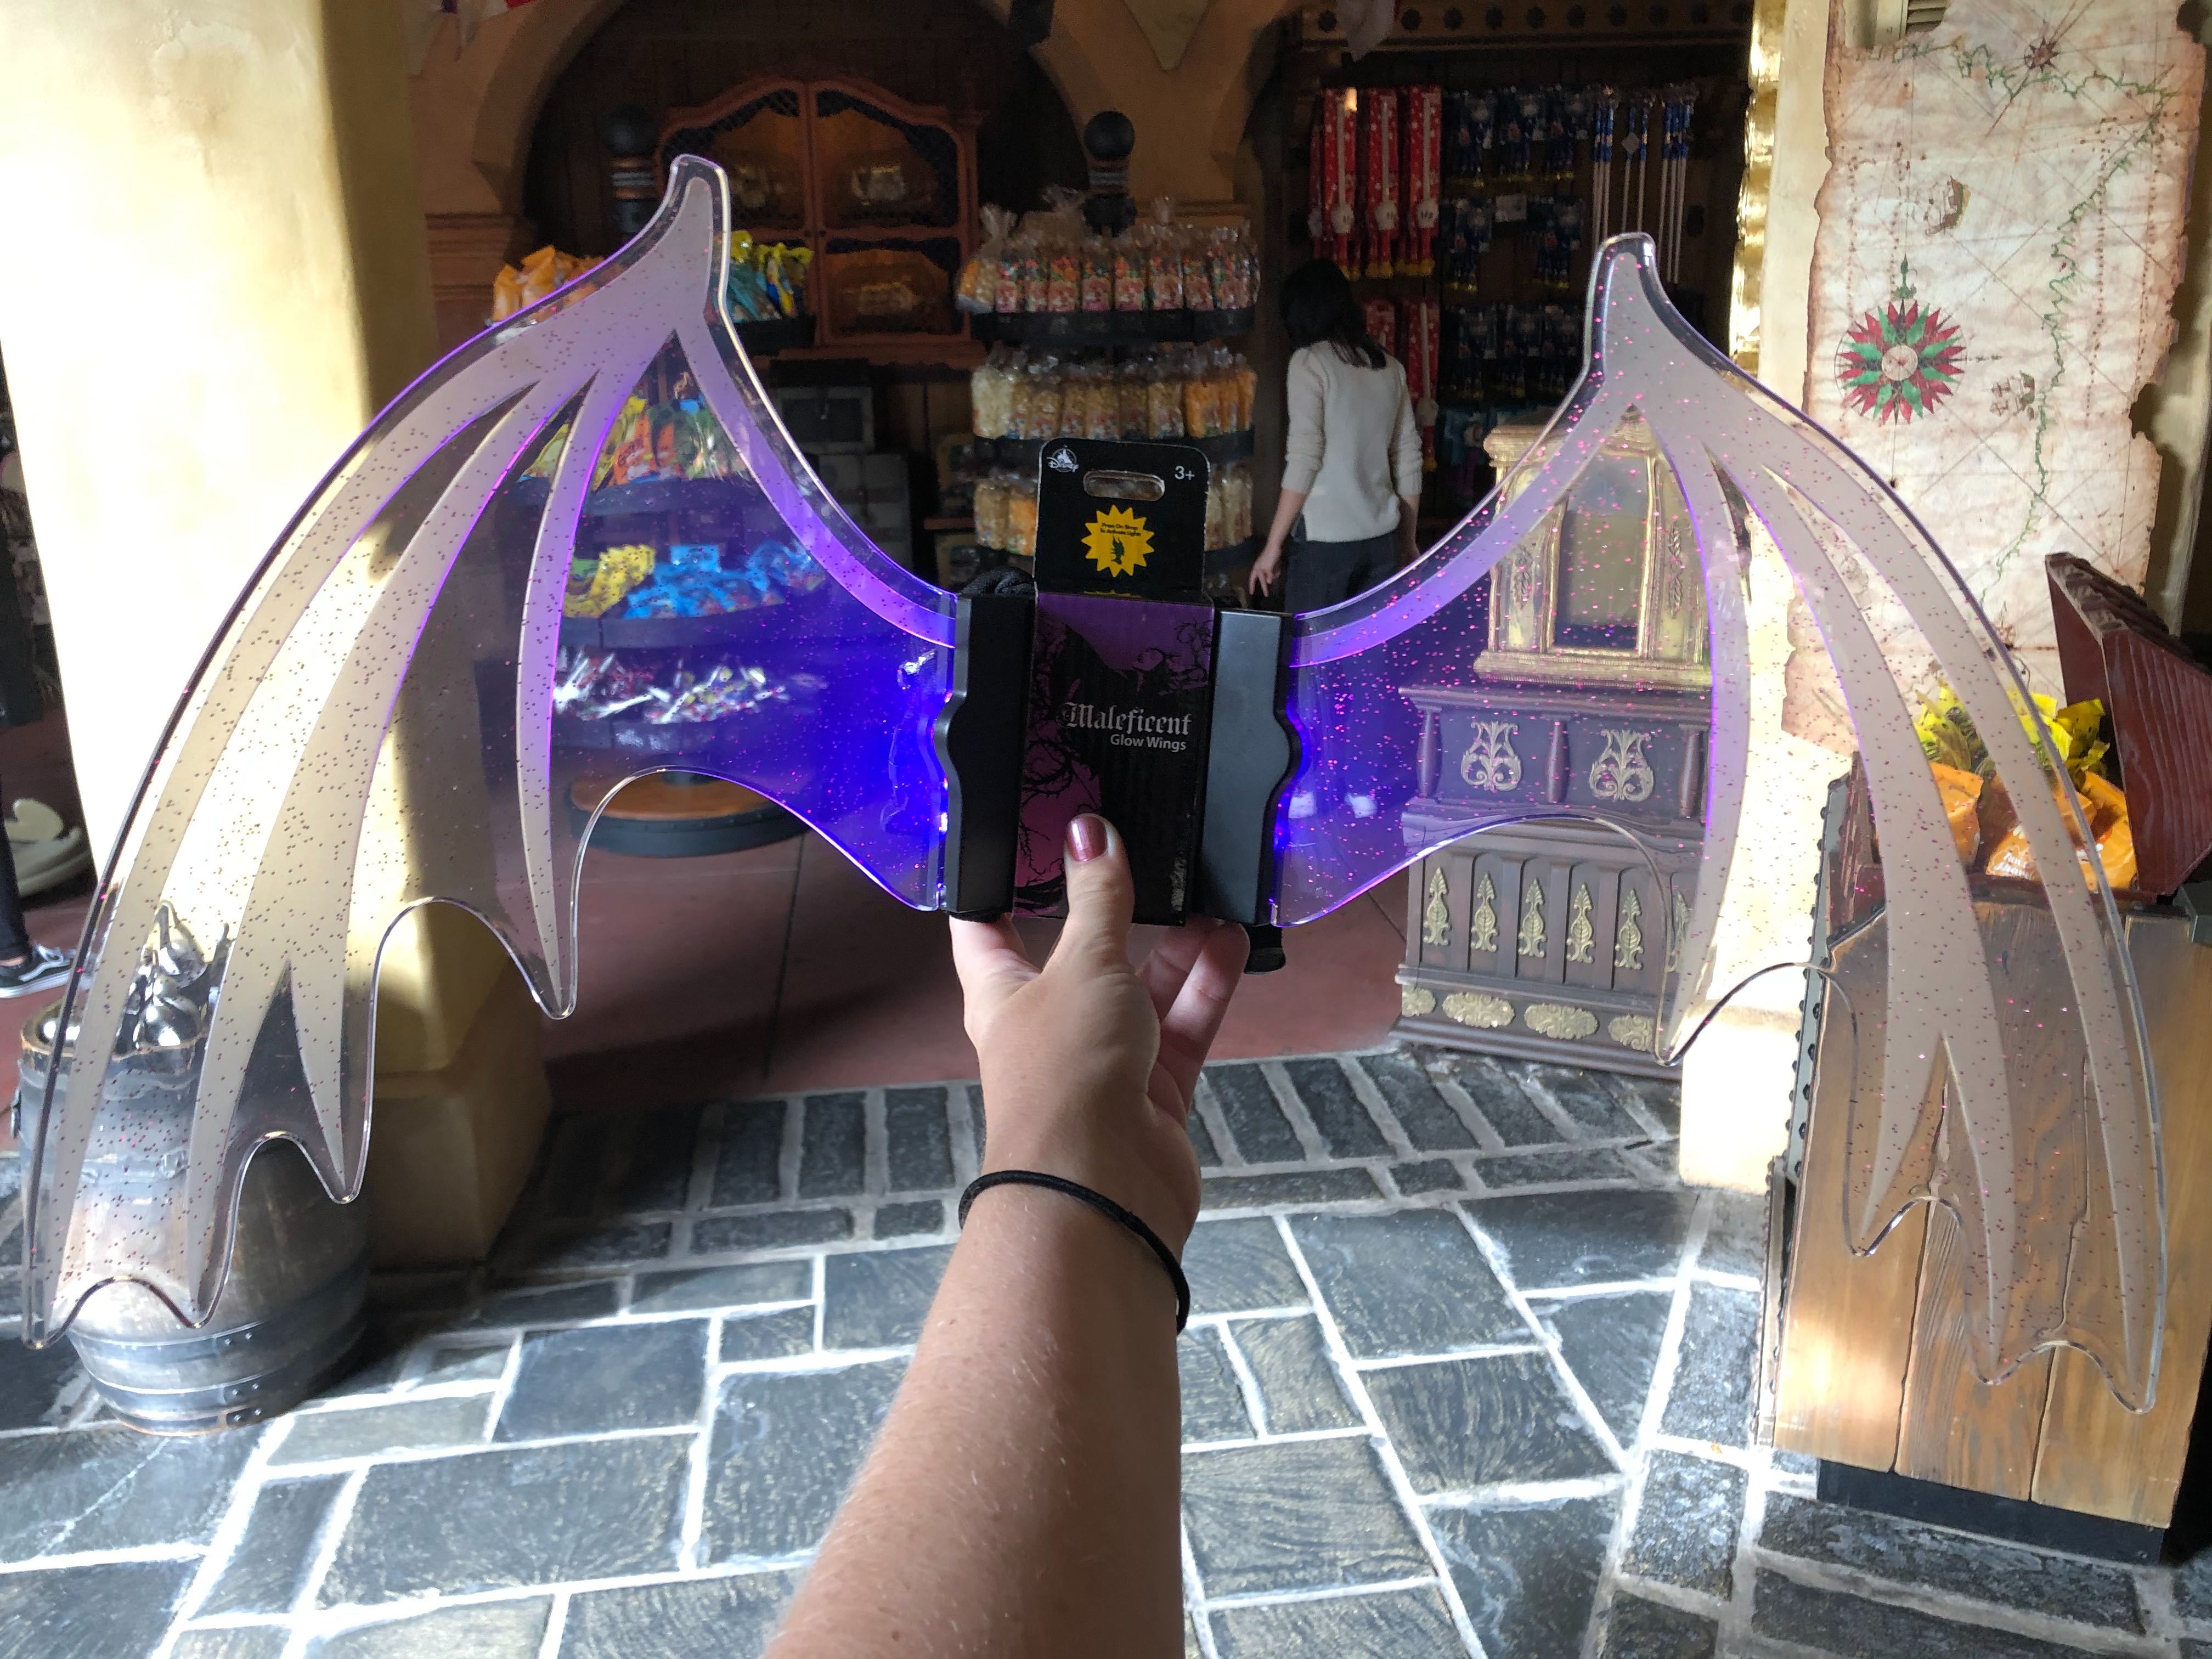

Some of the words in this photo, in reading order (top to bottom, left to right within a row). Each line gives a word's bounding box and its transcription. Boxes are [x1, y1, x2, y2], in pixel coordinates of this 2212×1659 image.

[1174, 465, 1195, 481] 3+
[1061, 702, 1192, 736] Maleficent
[1110, 733, 1144, 747] Glow
[1146, 736, 1187, 753] Wings
